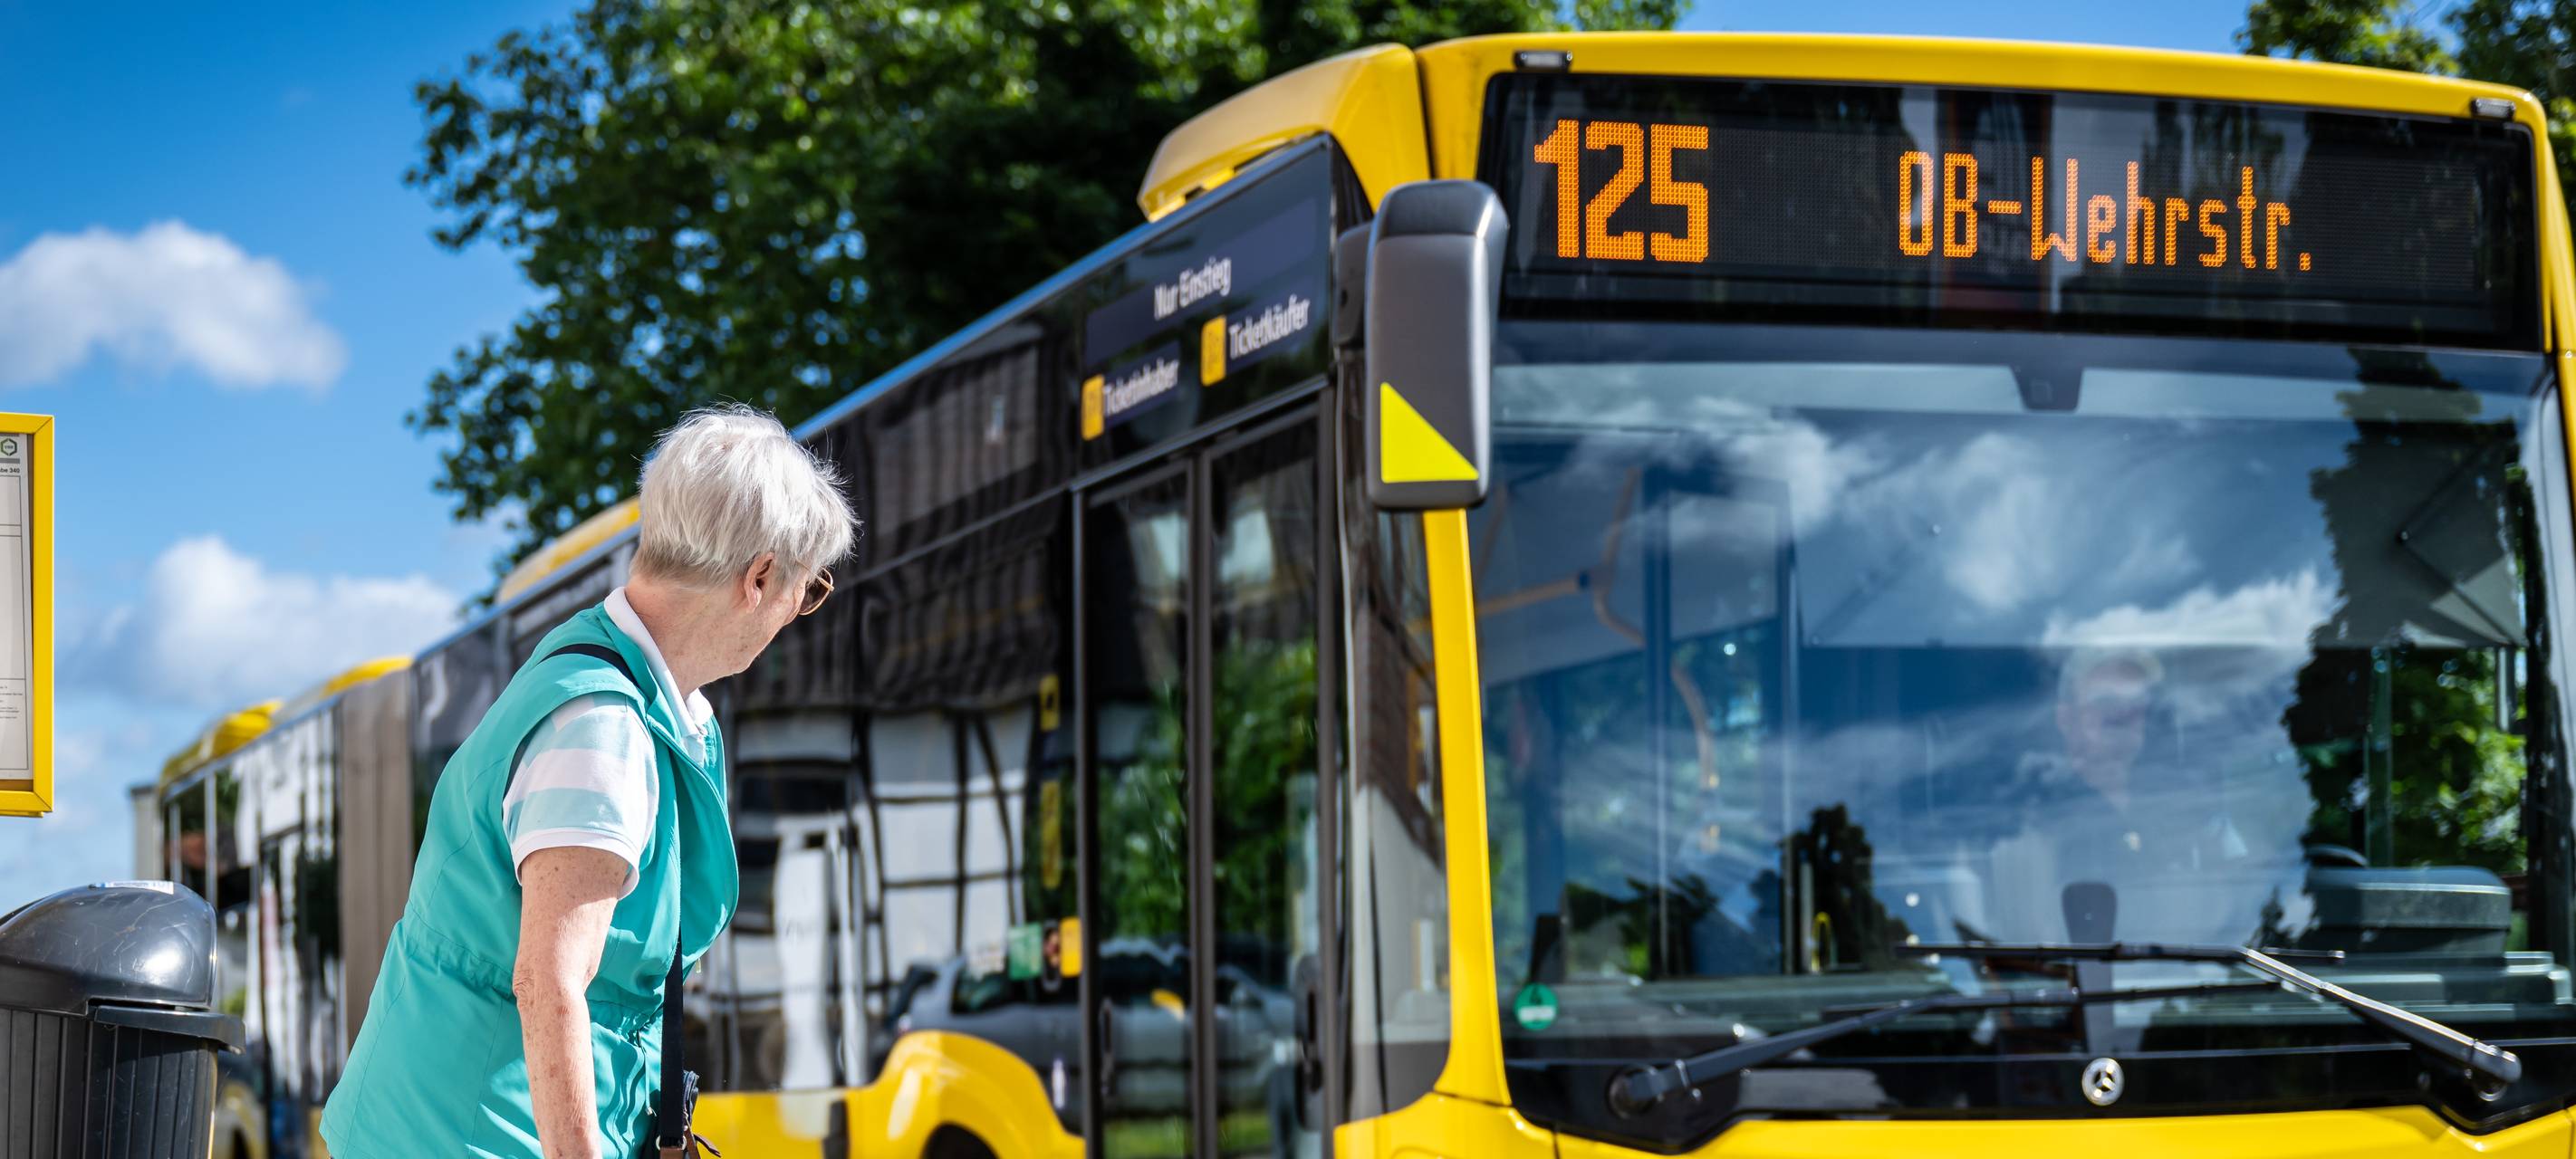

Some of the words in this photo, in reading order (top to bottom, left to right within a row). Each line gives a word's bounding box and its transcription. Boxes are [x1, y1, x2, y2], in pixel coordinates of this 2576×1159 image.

[1533, 119, 1709, 263] 125
[1898, 150, 2312, 272] OB-Wehrstr.
[1154, 283, 1178, 321] Nur
[1179, 255, 1232, 308] Einstieg
[1228, 293, 1311, 360] Ticketkäufer
